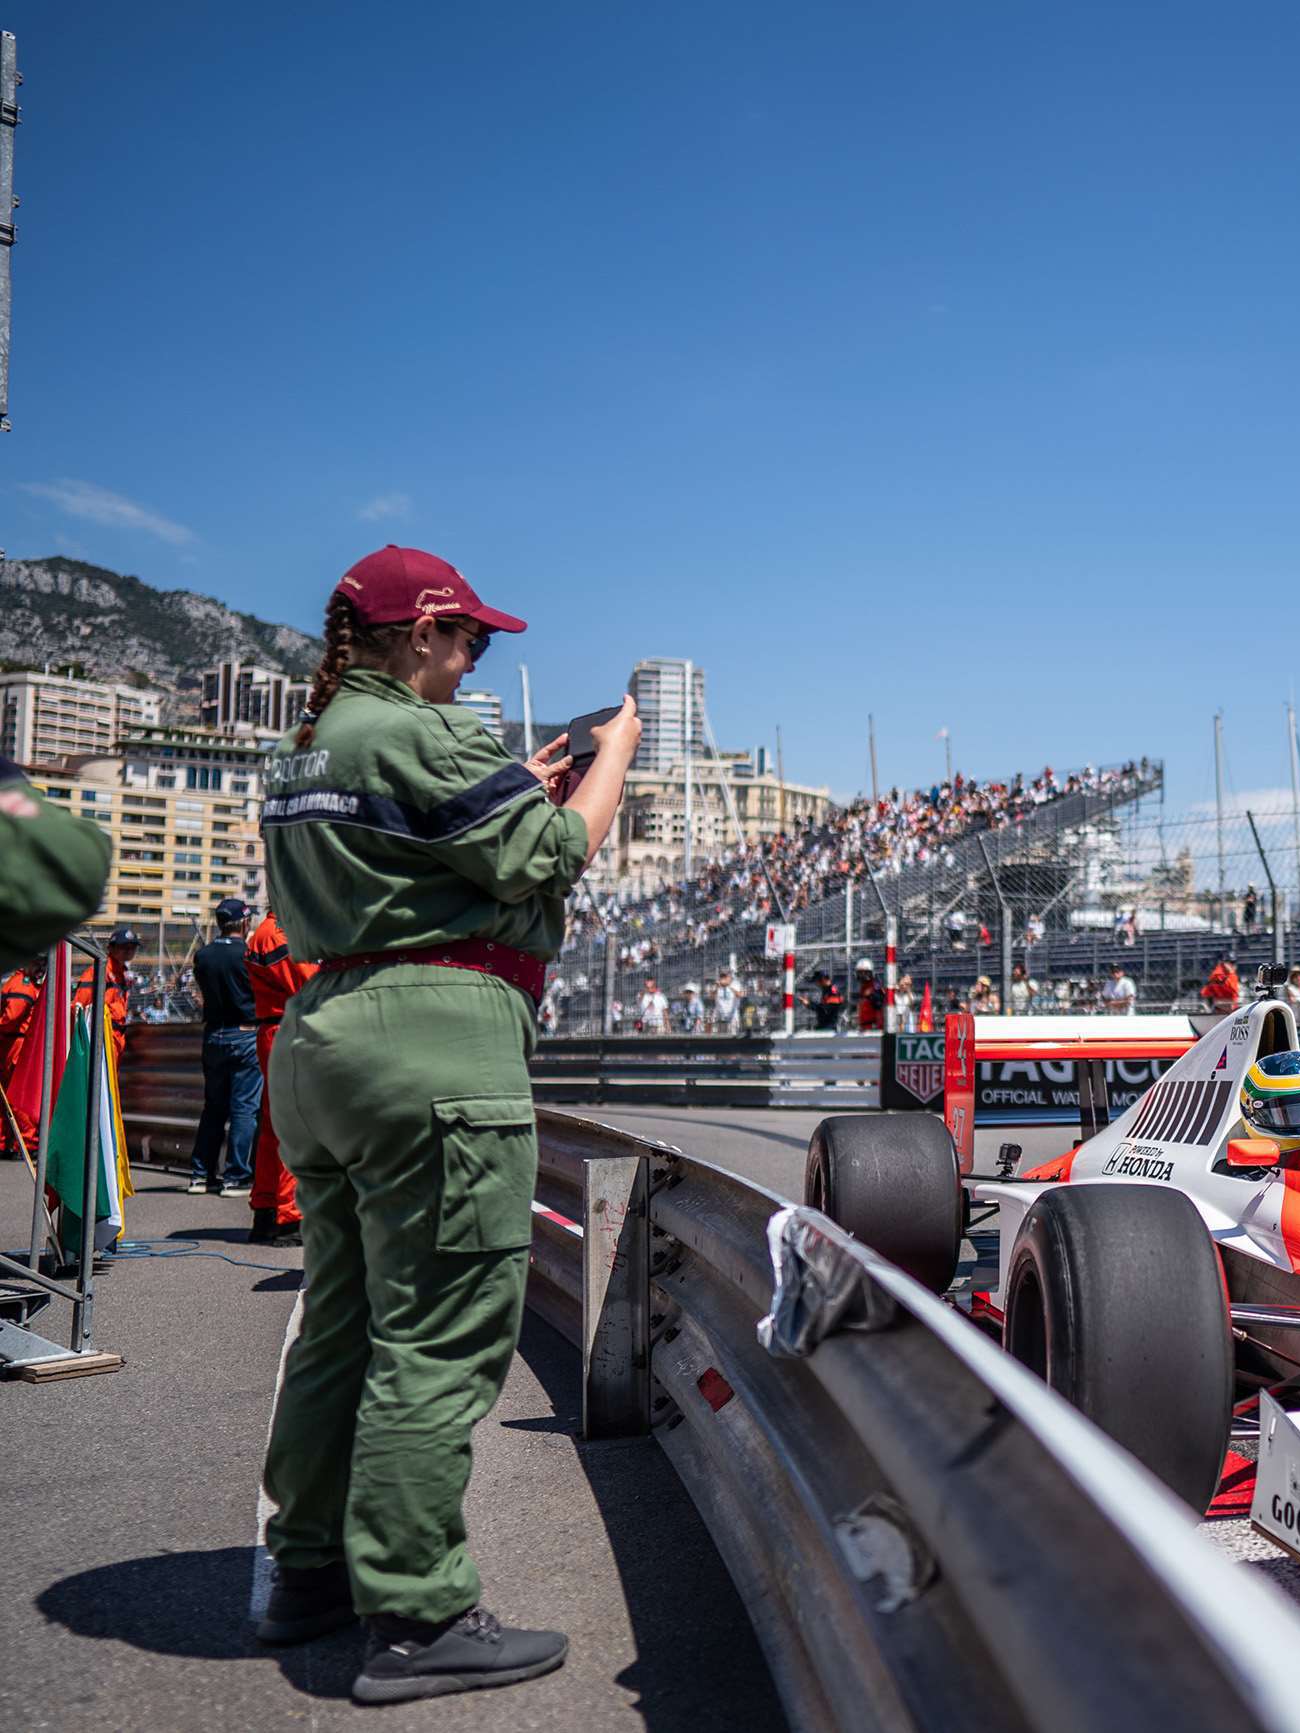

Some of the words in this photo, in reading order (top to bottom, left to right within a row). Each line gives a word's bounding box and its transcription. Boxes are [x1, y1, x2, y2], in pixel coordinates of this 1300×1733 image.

[902, 1038, 945, 1061] TAG
[898, 1065, 945, 1099] HEUE
[982, 1088, 1047, 1105] OFFICIAL
[1051, 1090, 1081, 1106] WAT
[1117, 1156, 1175, 1181] HONDA
